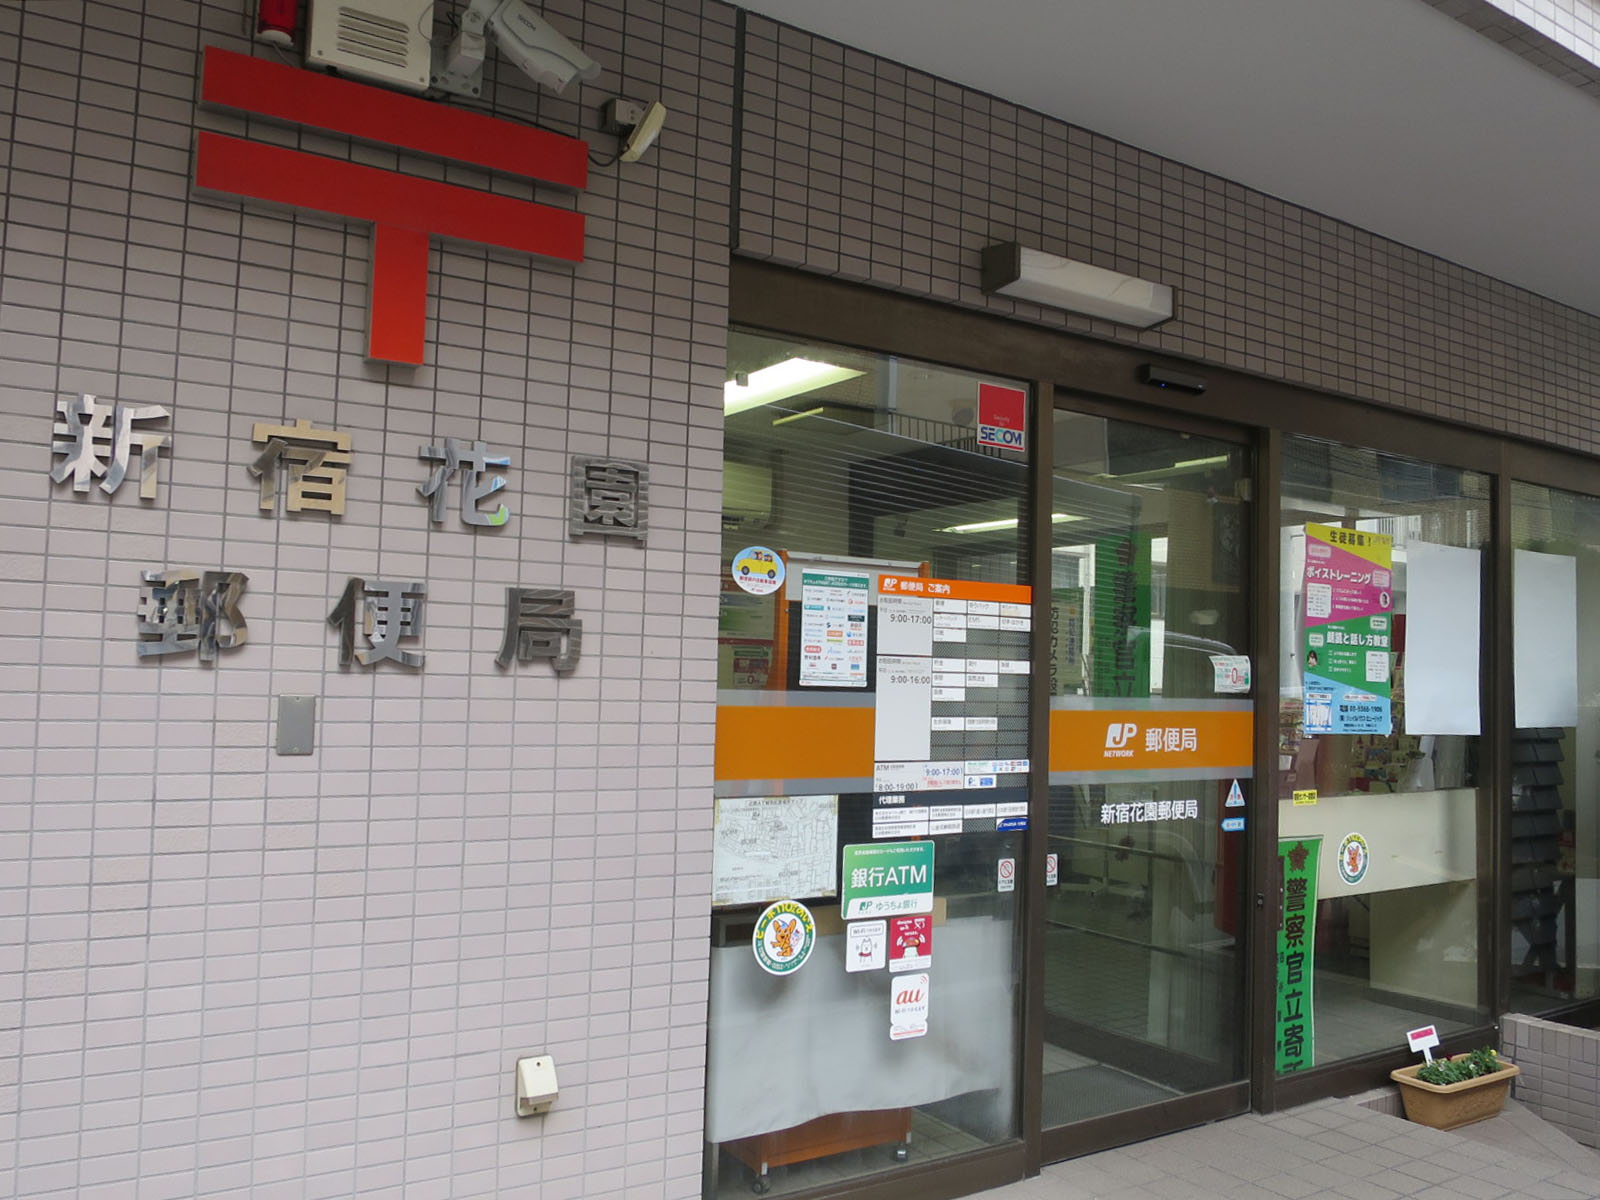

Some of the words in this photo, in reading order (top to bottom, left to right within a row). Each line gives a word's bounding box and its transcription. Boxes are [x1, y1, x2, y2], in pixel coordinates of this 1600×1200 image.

[981, 426, 1022, 446] SECOM
[49, 394, 649, 547] 新宿花園
[928, 583, 950, 594] ご案内
[138, 570, 583, 672] 郵便局
[890, 614, 931, 624] 9:00-17:00
[890, 675, 931, 684] 9:00-16:00
[1145, 728, 1197, 752] 郵便局
[1104, 750, 1134, 758] NETWORK
[1101, 800, 1198, 825] 新宿花園郵便局
[851, 865, 927, 888] 銀行ATM
[876, 900, 917, 910] ゆうちょ銀行
[896, 989, 925, 1005] au
